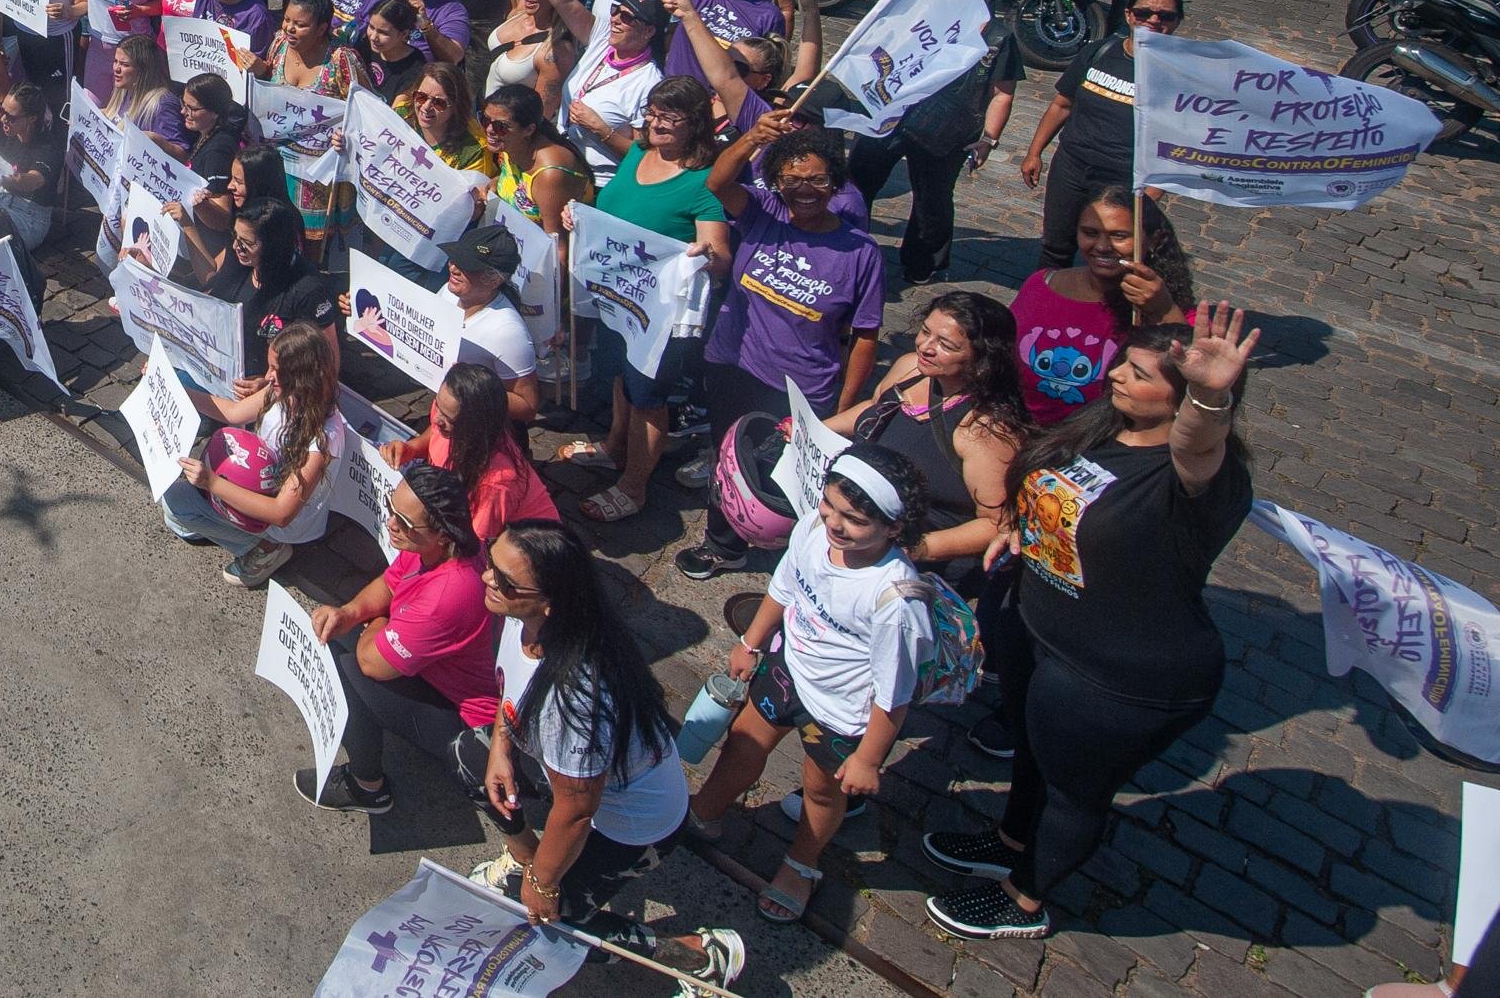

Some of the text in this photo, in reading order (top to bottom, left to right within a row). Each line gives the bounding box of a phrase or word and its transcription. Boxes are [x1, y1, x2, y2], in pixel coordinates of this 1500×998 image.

[180, 32, 226, 53] TODOS JUNTOS
[183, 42, 228, 65] Contra
[182, 58, 188, 67] O
[1234, 69, 1301, 94] POR
[286, 101, 307, 122] POR
[1174, 92, 1250, 121] VOZ,
[1270, 86, 1384, 126] PROTEÇÃO
[78, 113, 93, 132] VOZ,
[267, 111, 287, 129] VOZ,
[378, 128, 405, 155] POR
[1201, 122, 1386, 152] E RESPEITO
[142, 150, 158, 171] POR
[359, 132, 377, 157] OZ,
[383, 153, 442, 202] PROTEÇÃO
[127, 154, 145, 176] VOZ,
[149, 171, 183, 203] PROTEÇ
[364, 163, 425, 209] RESPEITO
[589, 249, 614, 270] VOZ,
[606, 237, 629, 260] POR
[601, 272, 611, 283] E
[754, 250, 833, 295] VOZ, PROTEÇÃO
[752, 268, 764, 277] E
[763, 273, 817, 305] RESPEITO
[388, 293, 435, 332] TODA MULHER
[386, 307, 446, 353] TEM O DIREITO DE
[385, 320, 405, 342] VIVER
[405, 335, 420, 352] SEM
[419, 342, 444, 368] MEDO.
[349, 466, 367, 489] QUE
[358, 489, 381, 516] ESTAR
[279, 629, 335, 746] QUE PUDERAM
[287, 656, 310, 695] ESTAR
[310, 689, 321, 722] AQUI
[313, 648, 325, 681] POR
[325, 671, 337, 718] TODAS
